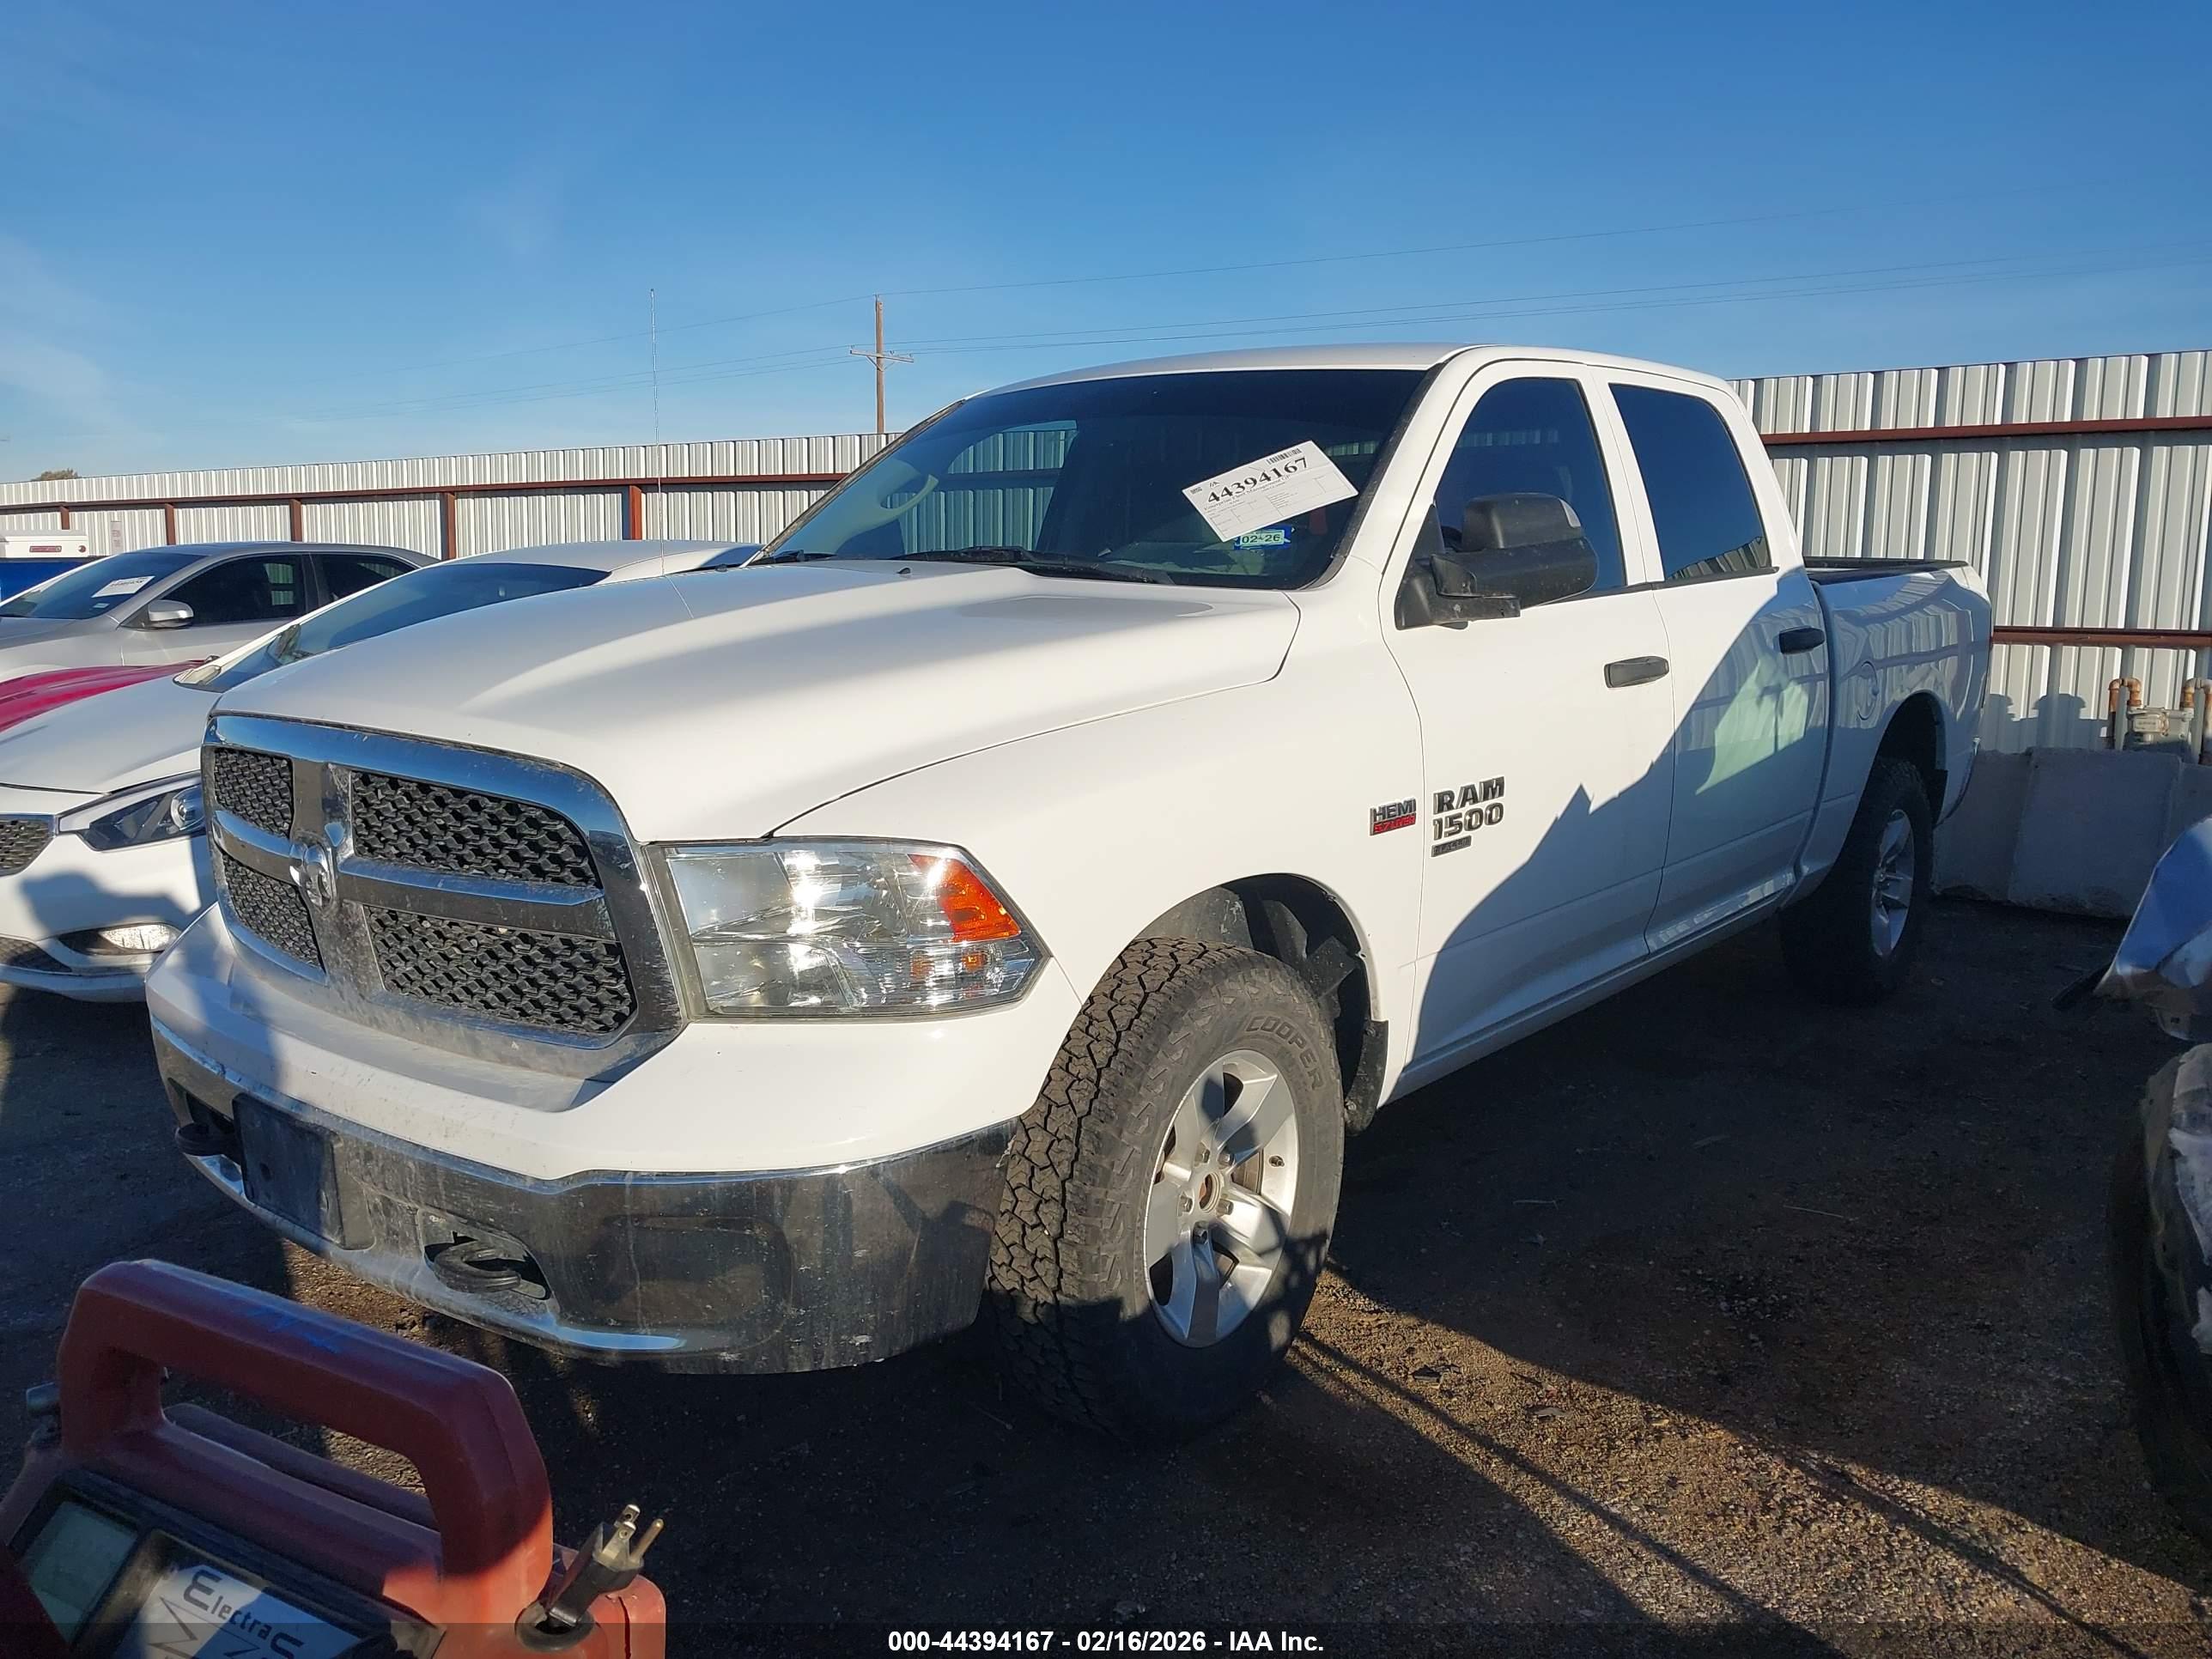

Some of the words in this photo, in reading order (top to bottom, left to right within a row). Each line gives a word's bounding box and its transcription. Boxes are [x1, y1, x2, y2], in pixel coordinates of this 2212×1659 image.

[1207, 457, 1308, 504] 44394167
[1370, 798, 1417, 823] HEMI
[1433, 776, 1504, 815] RAM
[1432, 802, 1504, 841] 1500
[1246, 1016, 1326, 1091] COOPER
